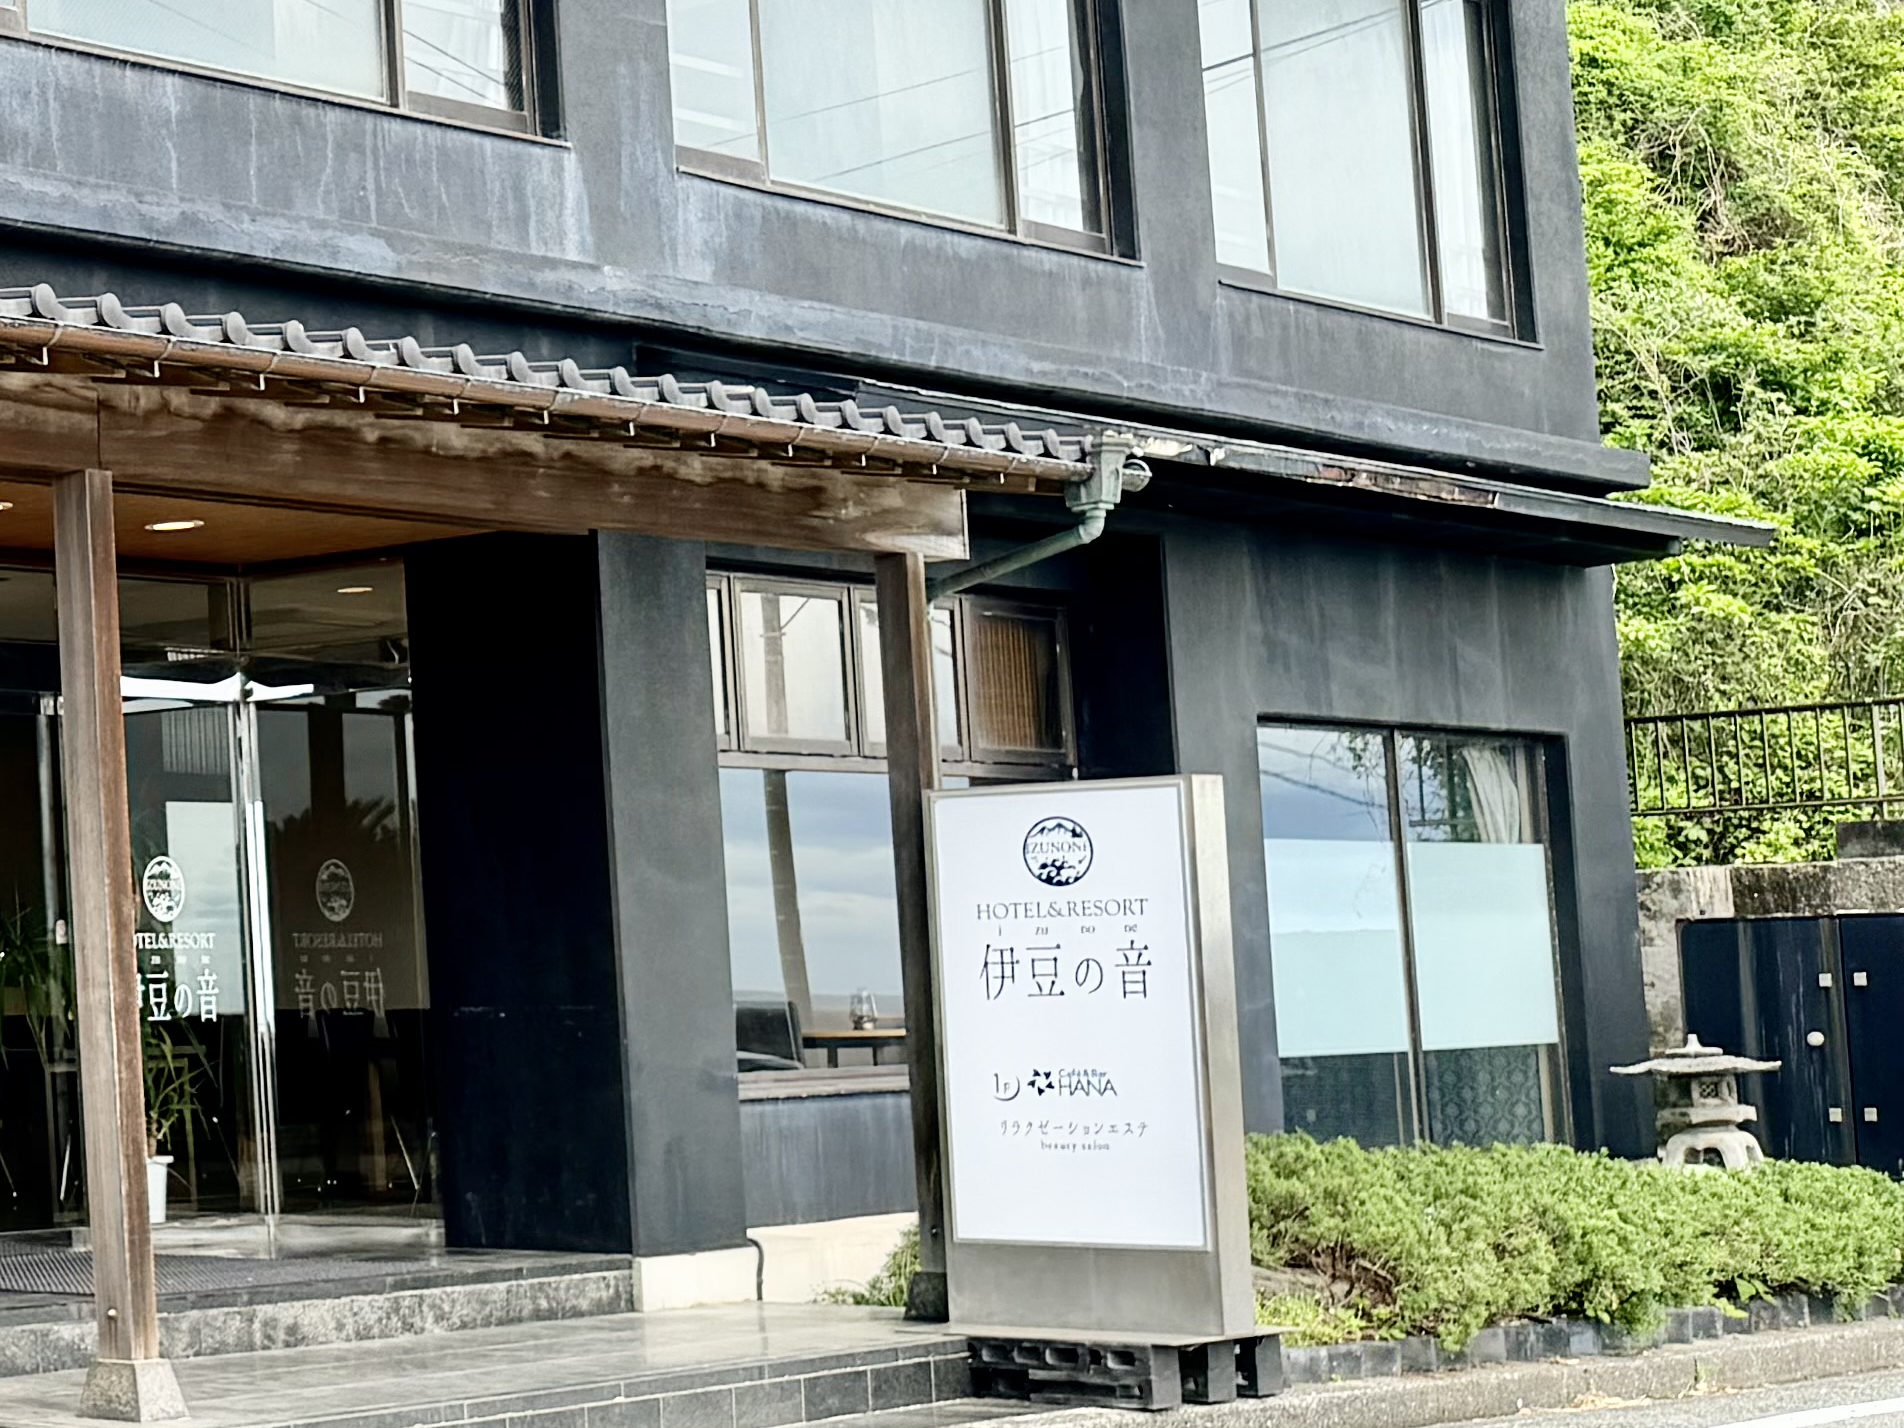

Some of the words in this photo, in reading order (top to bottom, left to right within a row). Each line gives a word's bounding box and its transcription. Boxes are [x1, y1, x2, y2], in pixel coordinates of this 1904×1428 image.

[976, 898, 1149, 921] HOTEL&RESORT
[133, 932, 217, 950] TEL&RESORT
[979, 939, 1153, 1001] 伊豆の音
[1058, 1078, 1118, 1097] HANA
[1000, 1119, 1149, 1139] リラクゼーションエステ
